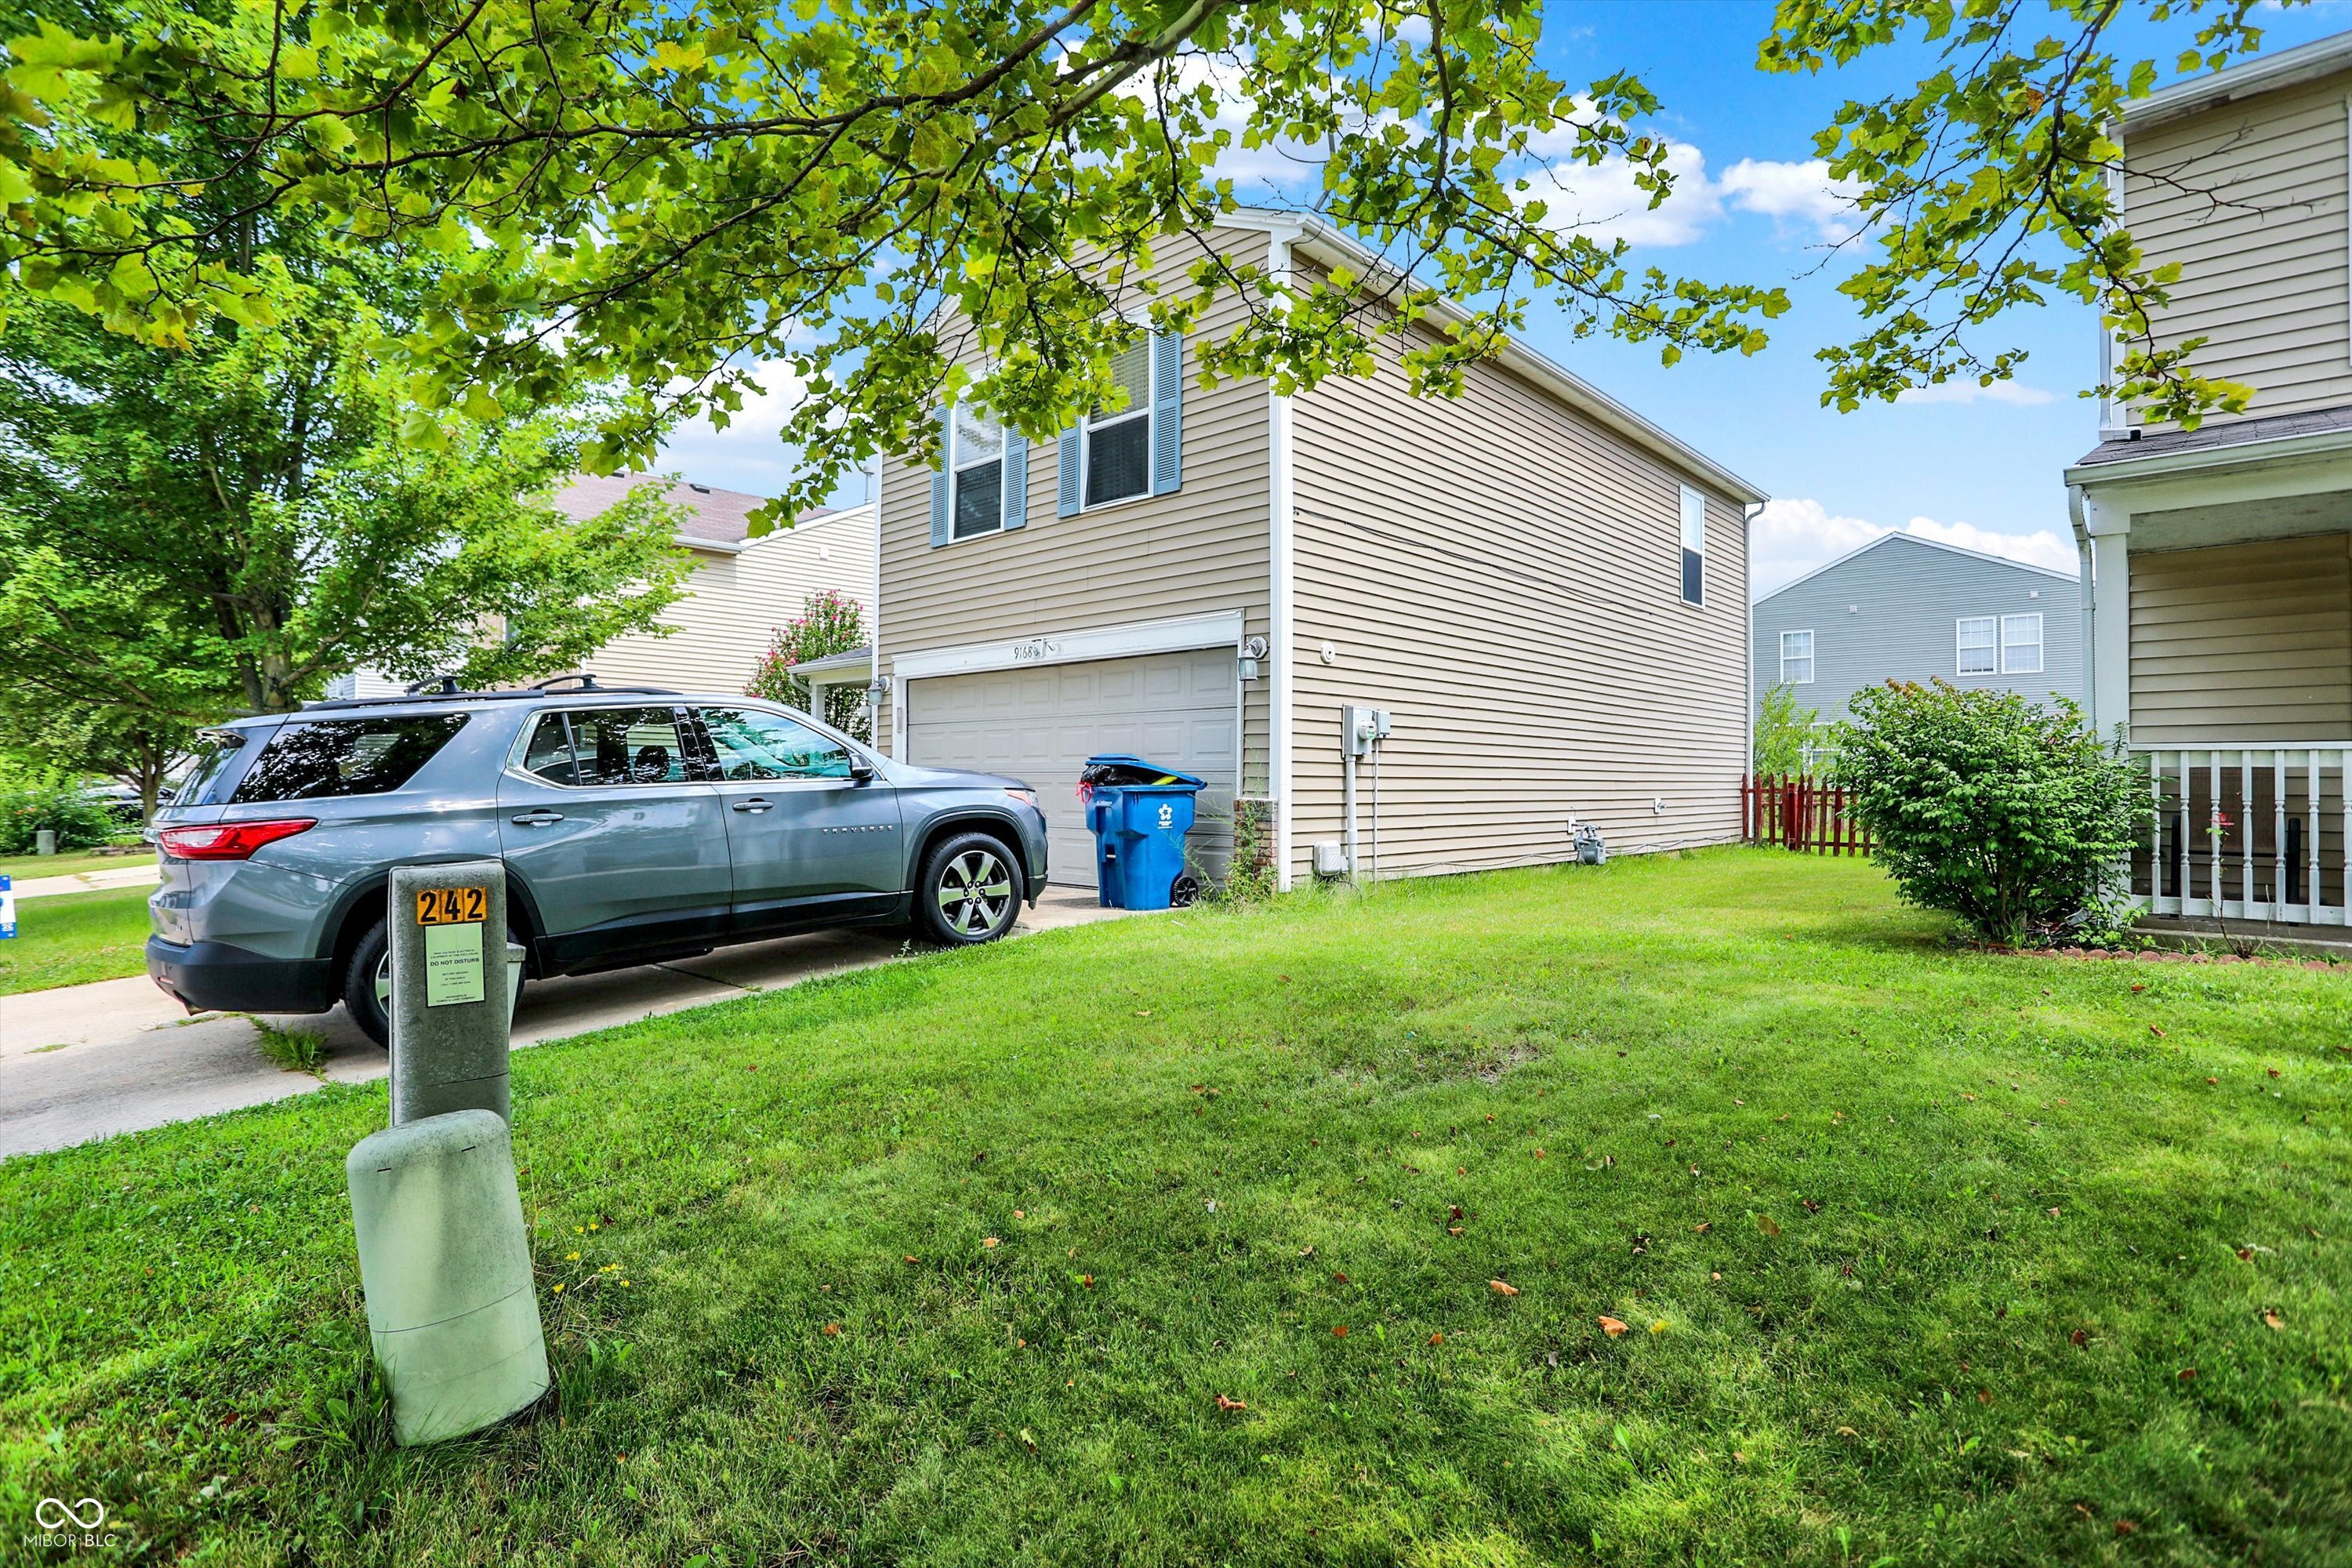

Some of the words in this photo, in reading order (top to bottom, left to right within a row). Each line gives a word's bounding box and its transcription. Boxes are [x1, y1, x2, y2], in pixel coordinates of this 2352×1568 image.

[1014, 646, 1033, 659] 9168
[822, 825, 893, 834] TRAVERSE
[420, 889, 483, 922] 242
